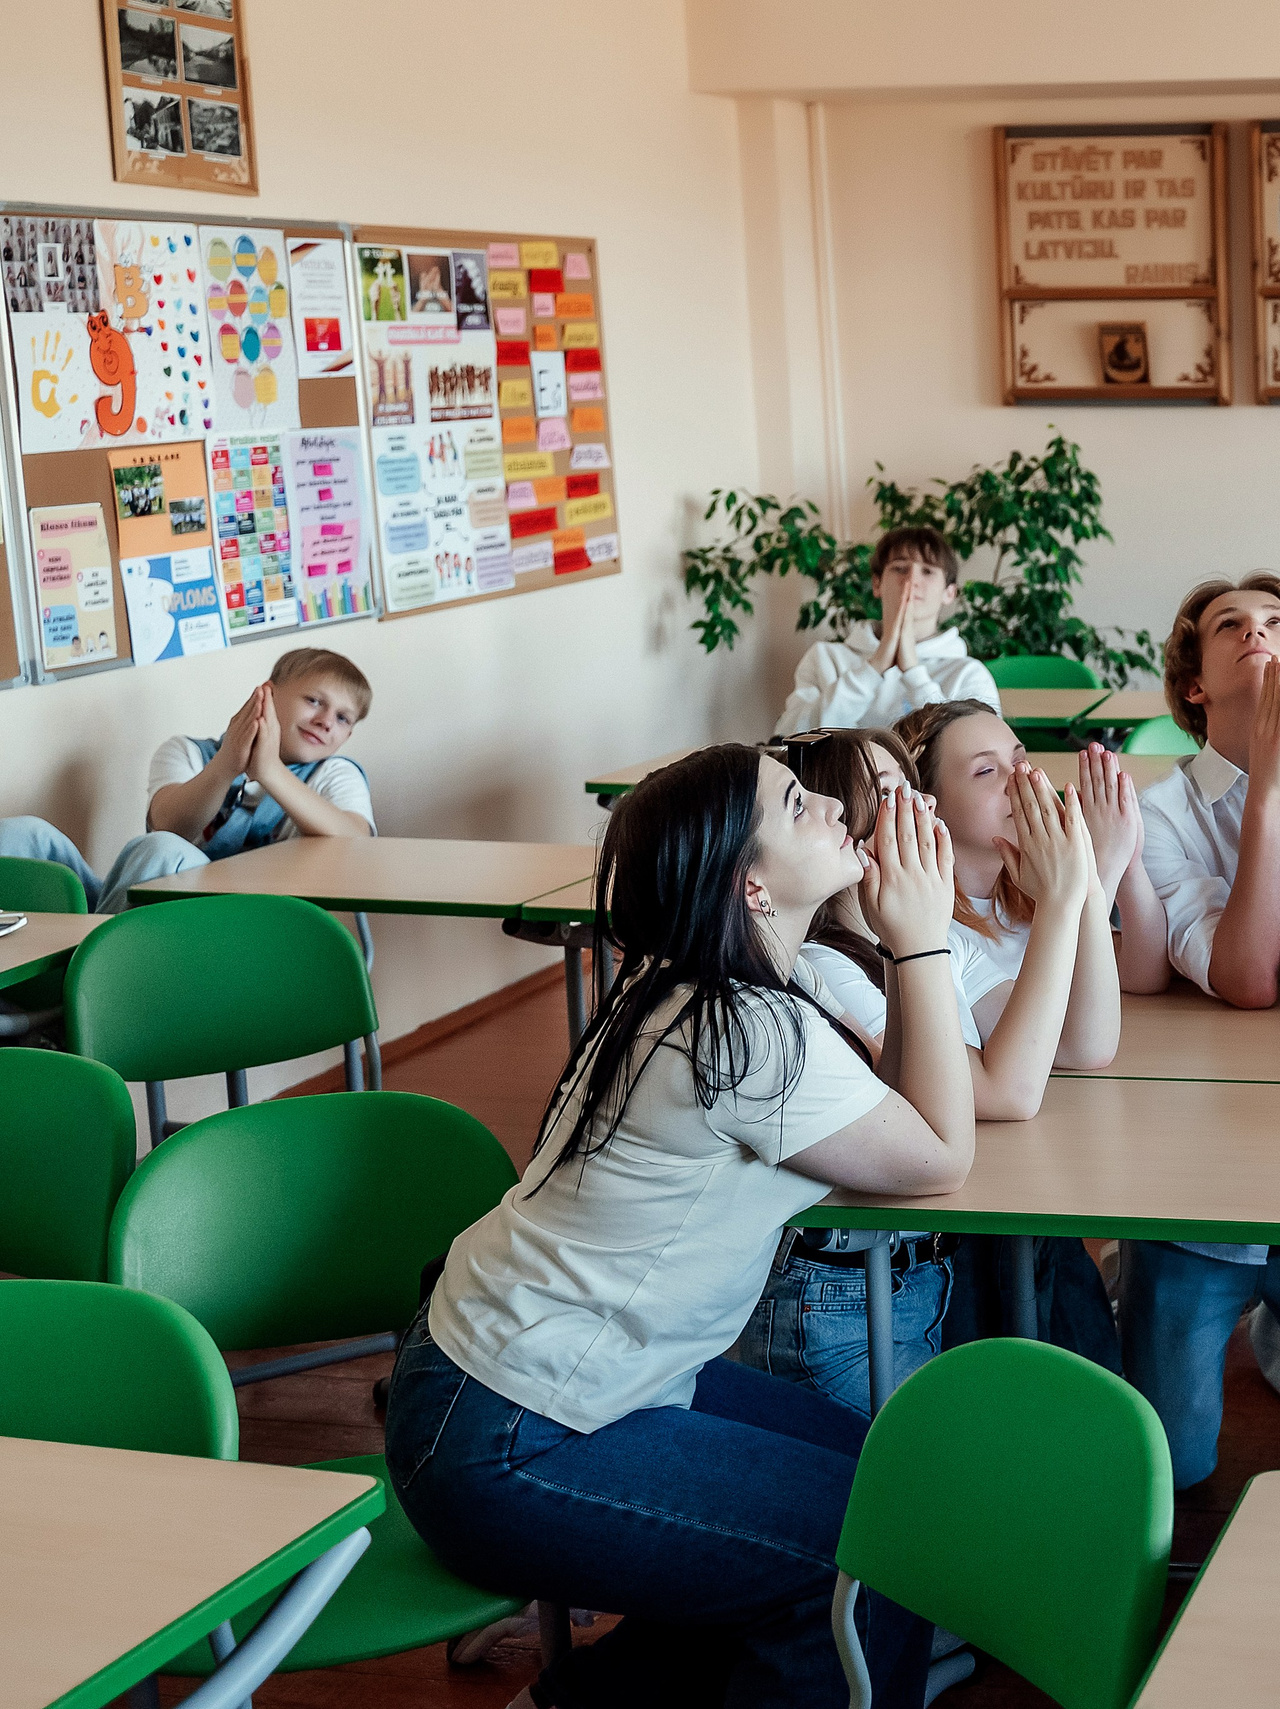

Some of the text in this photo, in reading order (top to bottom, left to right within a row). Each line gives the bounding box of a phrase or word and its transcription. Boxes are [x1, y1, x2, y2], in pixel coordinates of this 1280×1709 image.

[1032, 145, 1163, 172] STĀVĒT PAR
[1123, 178, 1147, 200] IR
[1154, 177, 1196, 198] TAS
[1092, 207, 1136, 229] KAS
[1144, 207, 1187, 229] PAR
[161, 585, 217, 613] DIPLOMS
